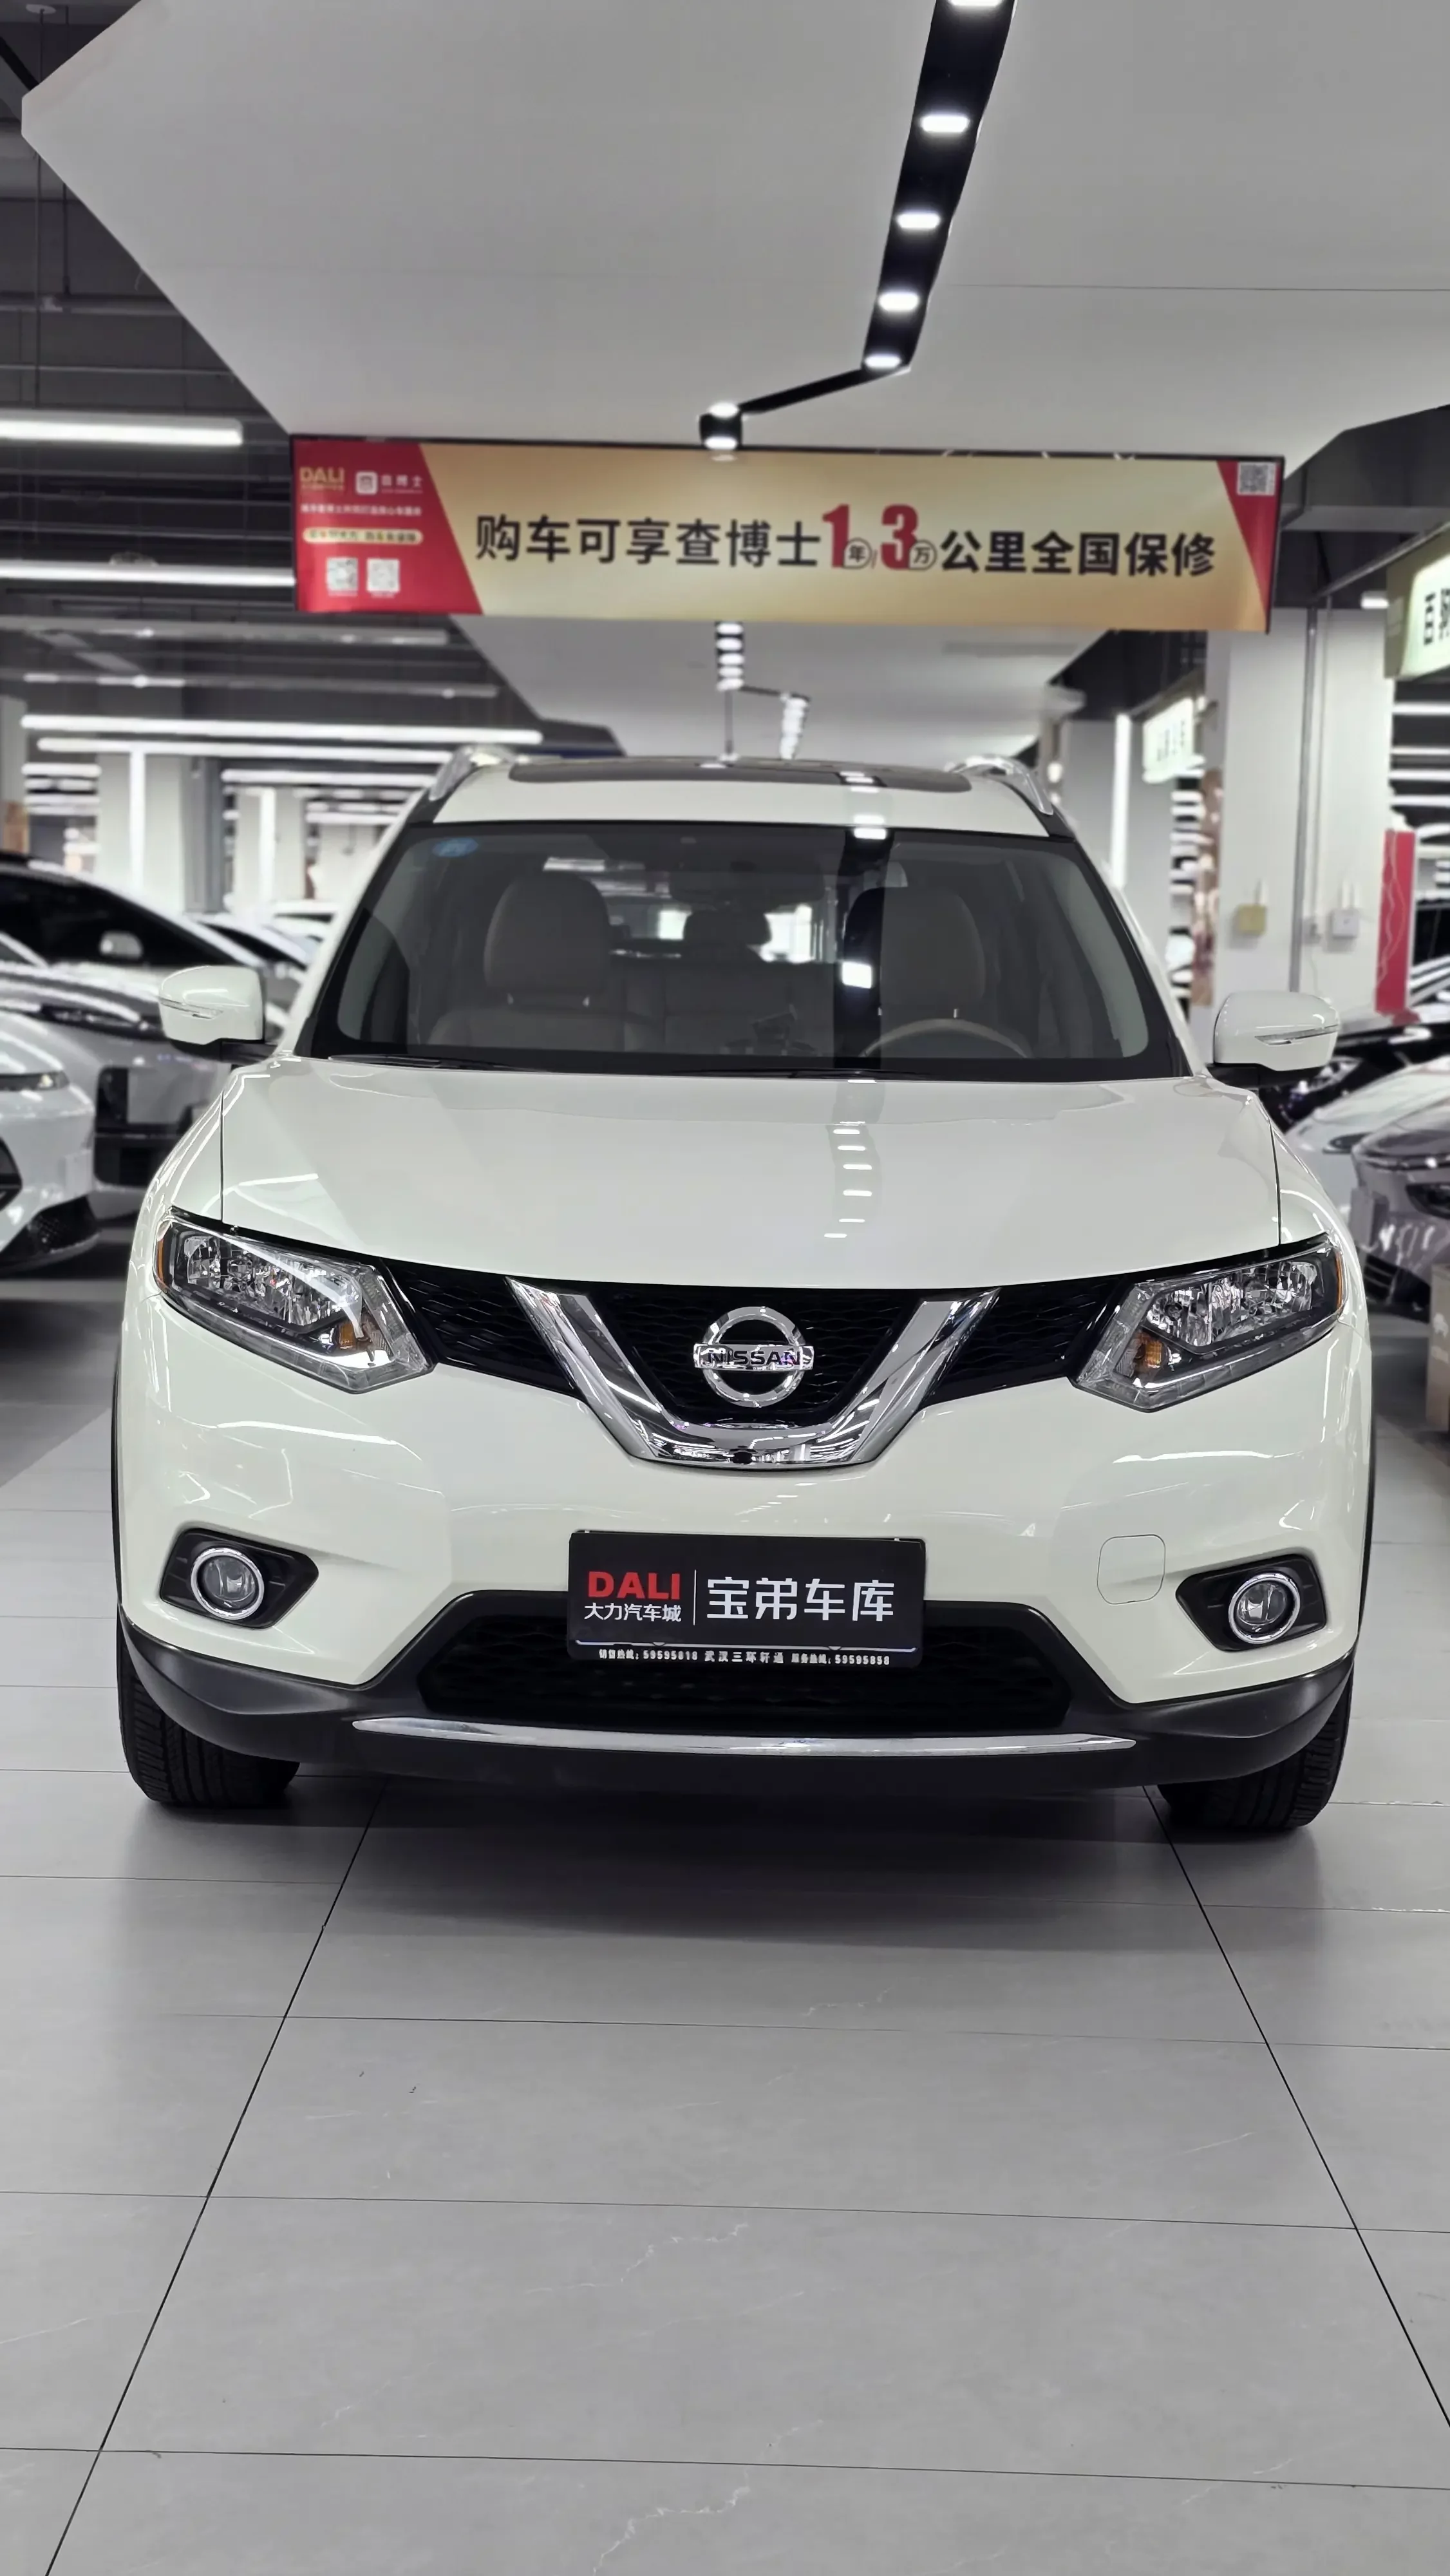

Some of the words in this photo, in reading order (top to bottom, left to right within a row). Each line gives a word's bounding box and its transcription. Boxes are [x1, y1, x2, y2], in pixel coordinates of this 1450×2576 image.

[300, 468, 344, 483] DALI
[708, 1350, 800, 1366] NISSAN
[588, 1571, 681, 1600] DALI
[707, 1577, 894, 1622] 宝弟车库
[583, 1602, 682, 1622] 大力汽车城
